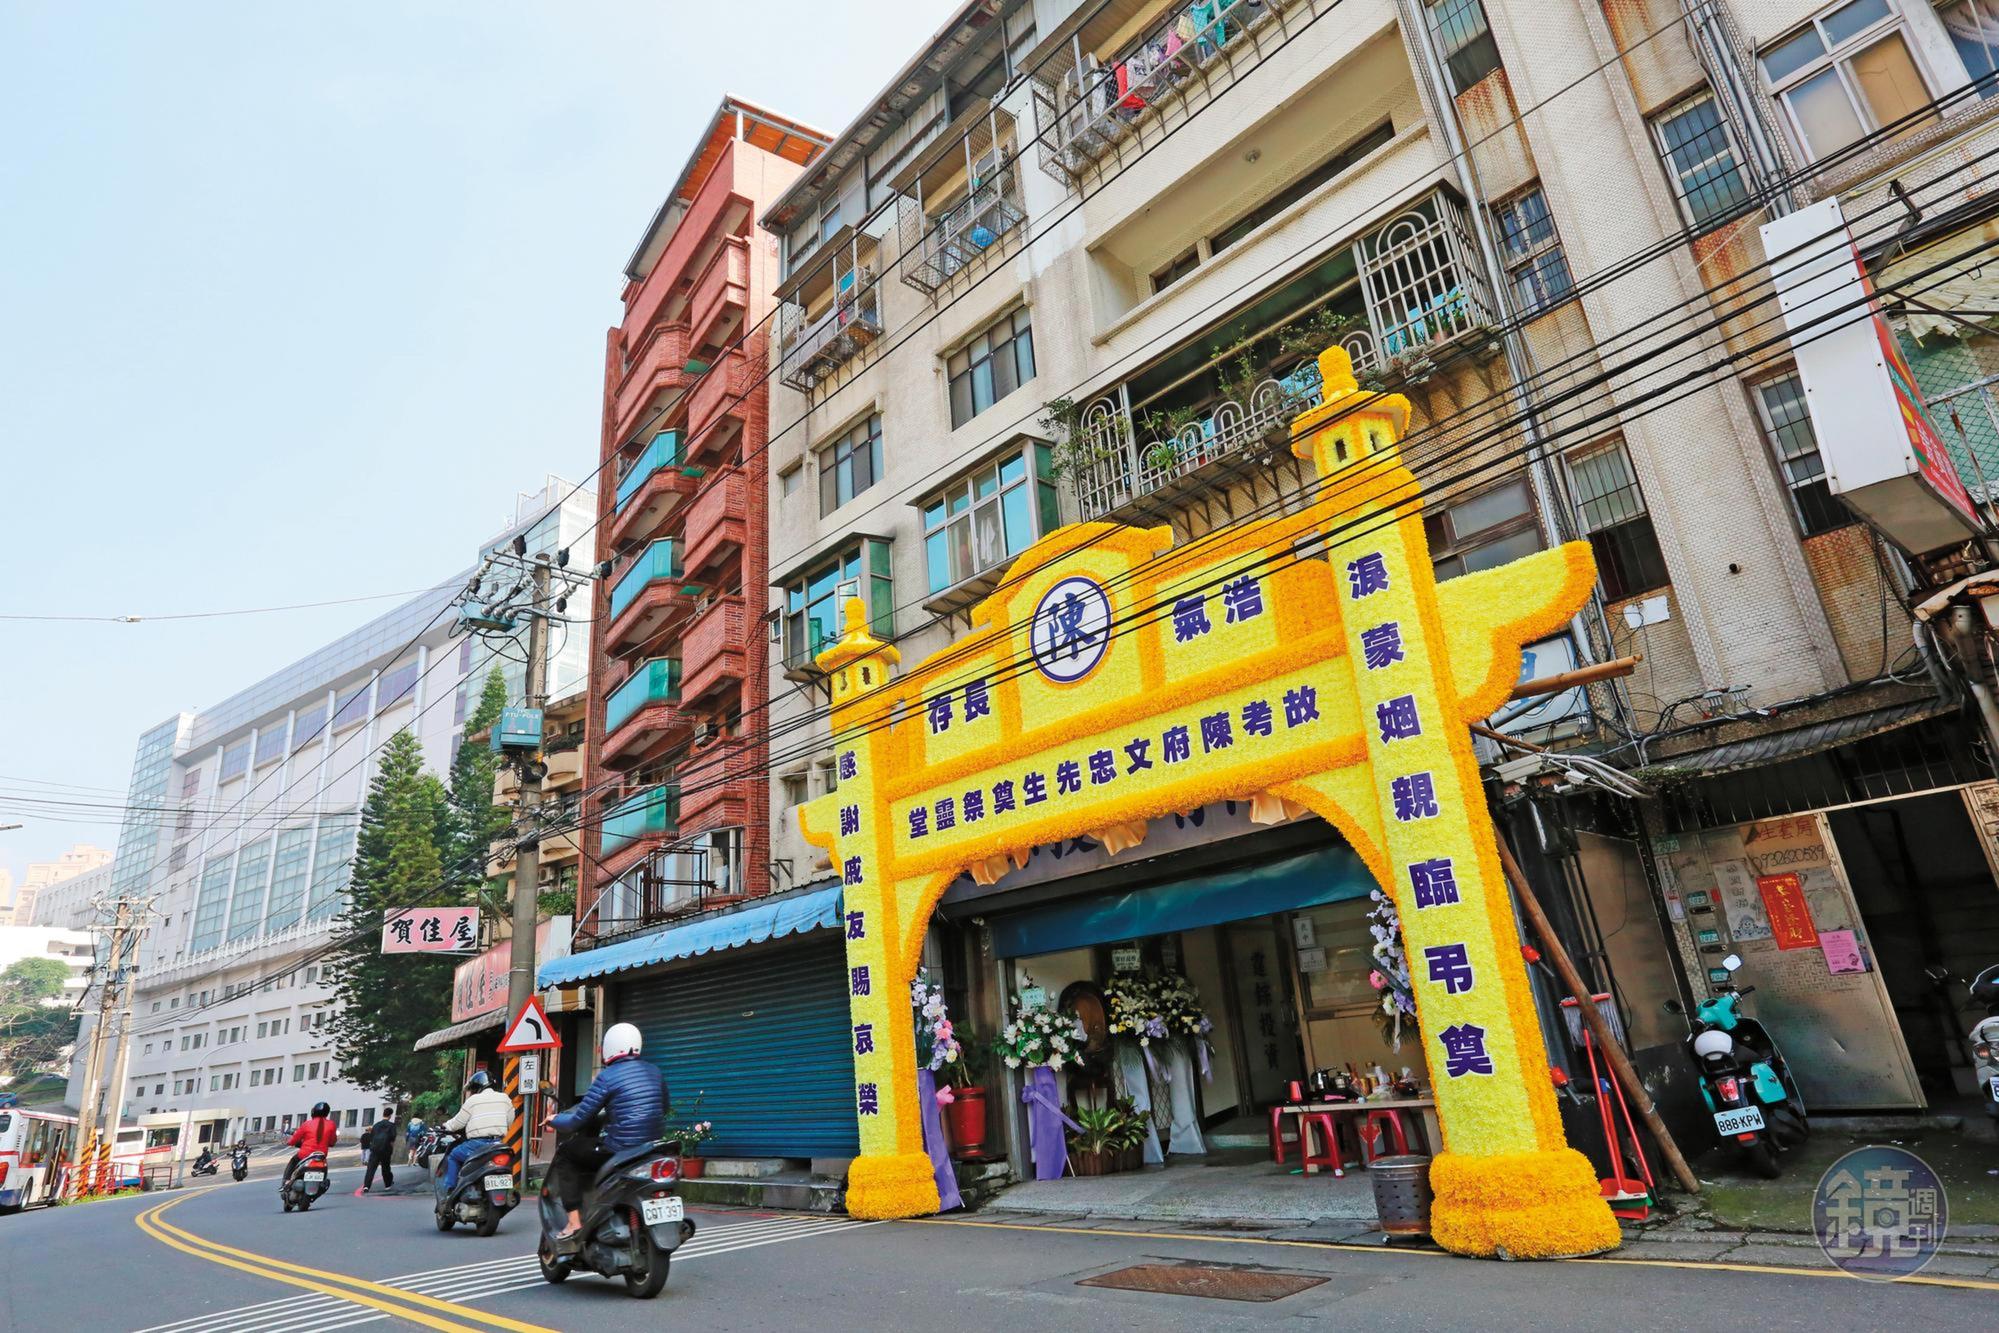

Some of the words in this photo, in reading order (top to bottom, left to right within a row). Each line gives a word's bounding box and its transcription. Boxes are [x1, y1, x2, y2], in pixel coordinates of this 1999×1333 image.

[1047, 592, 1098, 662] 陳
[1173, 573, 1265, 644] 浩氣
[927, 679, 991, 734] 長存
[908, 685, 1321, 839] 故考陳府文忠先生奠祭靈堂
[1347, 551, 1496, 1078] 淚蒙姻親臨弔奠
[390, 916, 474, 944] 賀佳屋
[840, 752, 879, 1115] 感謝戚友賜哀榮
